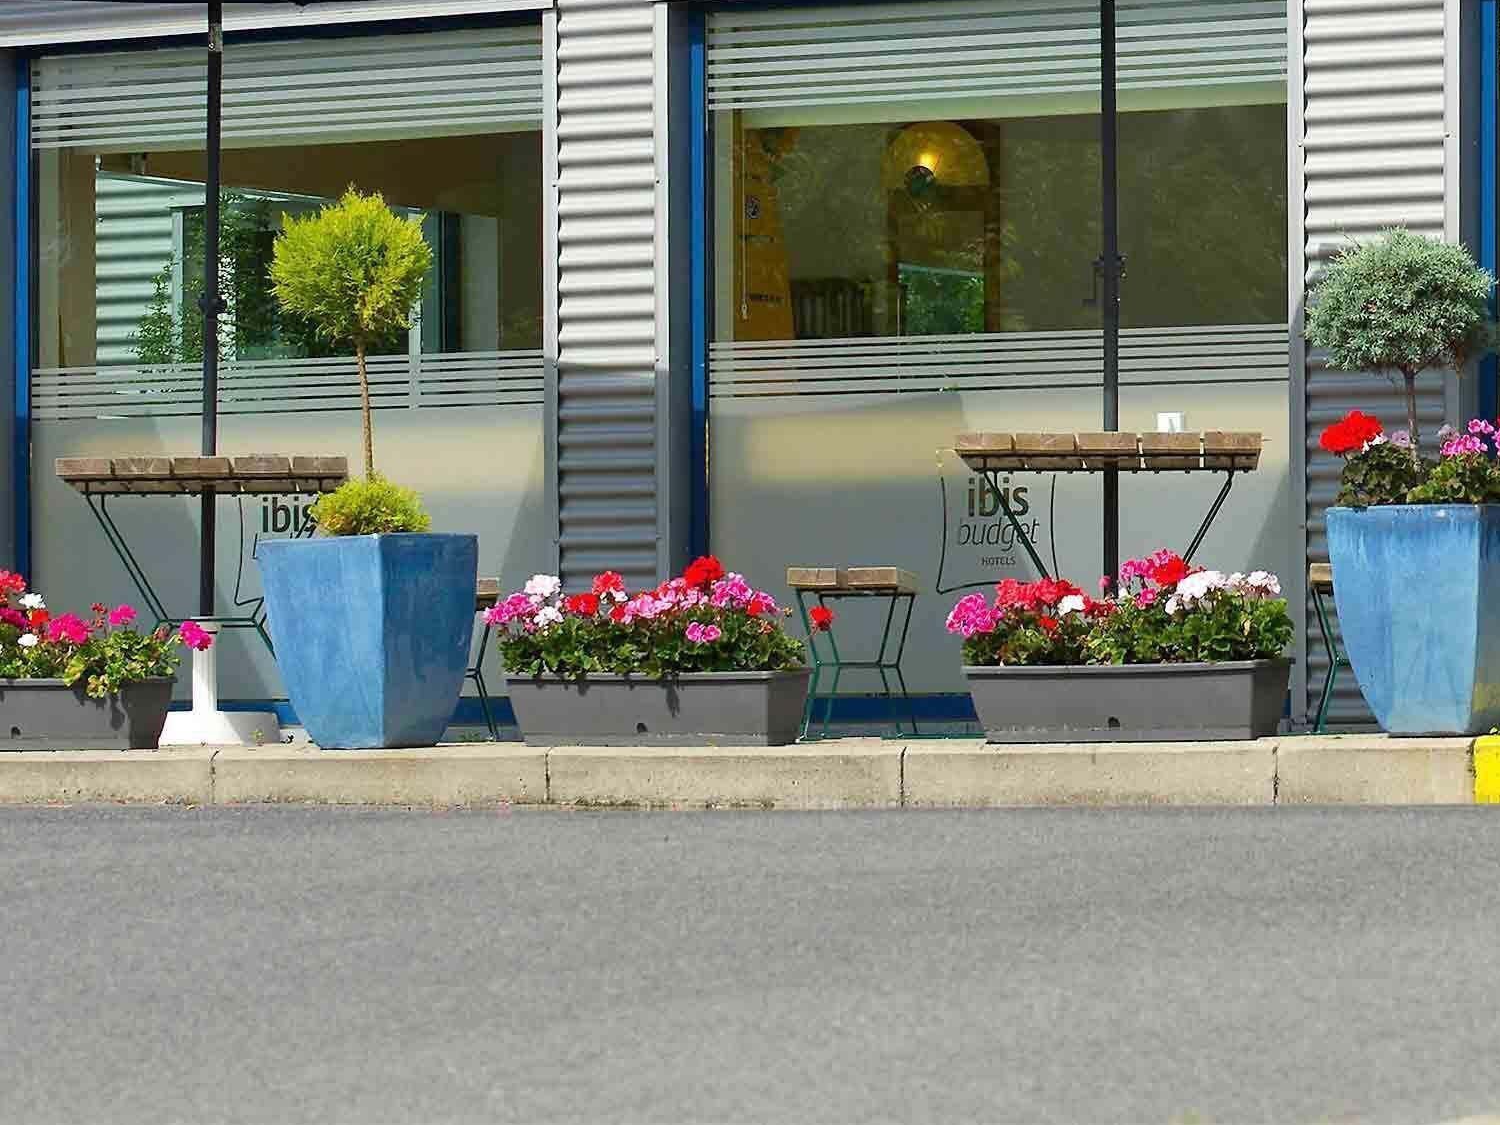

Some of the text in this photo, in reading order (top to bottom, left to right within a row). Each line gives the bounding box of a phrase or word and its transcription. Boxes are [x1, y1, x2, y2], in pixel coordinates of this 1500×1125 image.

[968, 476, 1030, 517] ibis
[958, 517, 1040, 552] budget
[981, 556, 1016, 566] HOTELS
